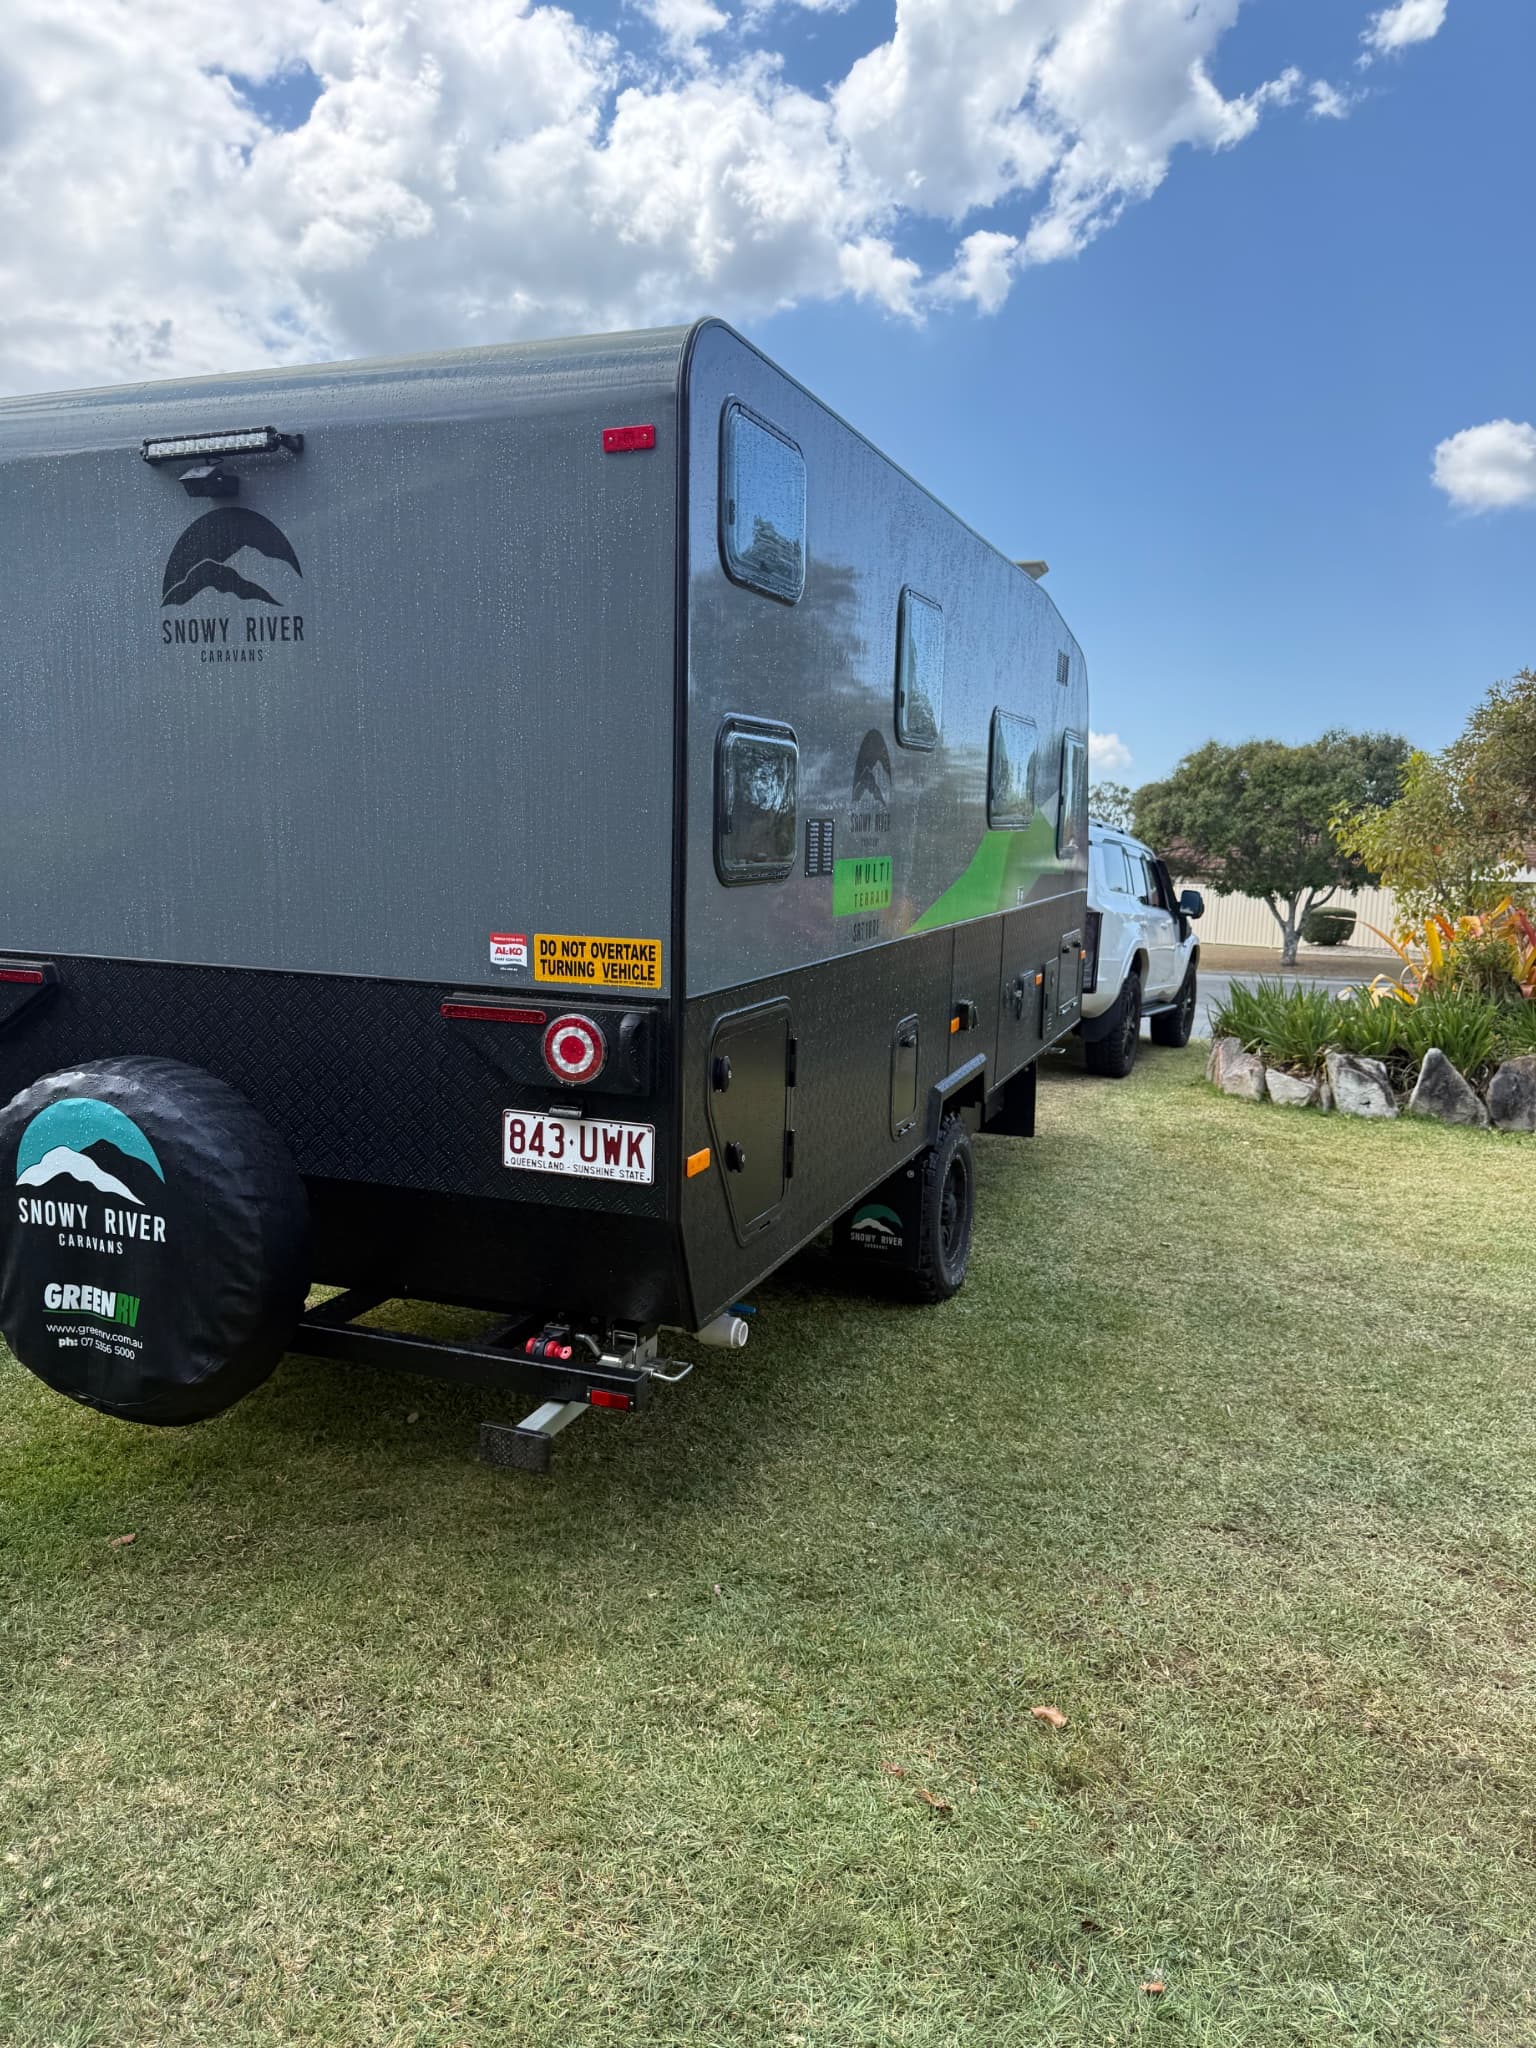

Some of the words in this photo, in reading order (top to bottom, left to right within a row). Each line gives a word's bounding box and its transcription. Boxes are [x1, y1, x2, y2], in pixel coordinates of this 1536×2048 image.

[162, 618, 230, 645] SNOWY
[246, 616, 305, 642] RIVER
[200, 649, 264, 663] CARAVANS
[855, 862, 890, 886] MULTI
[540, 939, 557, 957] DO
[561, 941, 587, 958] NOT
[590, 942, 656, 962] OVERTAKE
[540, 958, 595, 978] TURNING
[602, 962, 656, 982] VEHICLE
[510, 1157, 565, 1171] QUEENSLAND
[572, 1164, 615, 1177] SUNSHINE
[619, 1171, 646, 1181] STATE
[18, 1197, 88, 1230] SNOWY
[104, 1208, 166, 1243] RIVER
[58, 1233, 124, 1255] CARAVANS
[850, 1231, 877, 1243] SNOWY
[881, 1235, 903, 1247] RIVER
[46, 1324, 143, 1350] www.greenrv.com.au
[58, 1337, 78, 1348] ph:
[80, 1337, 94, 1347] 07
[114, 1345, 136, 1361] 5000
